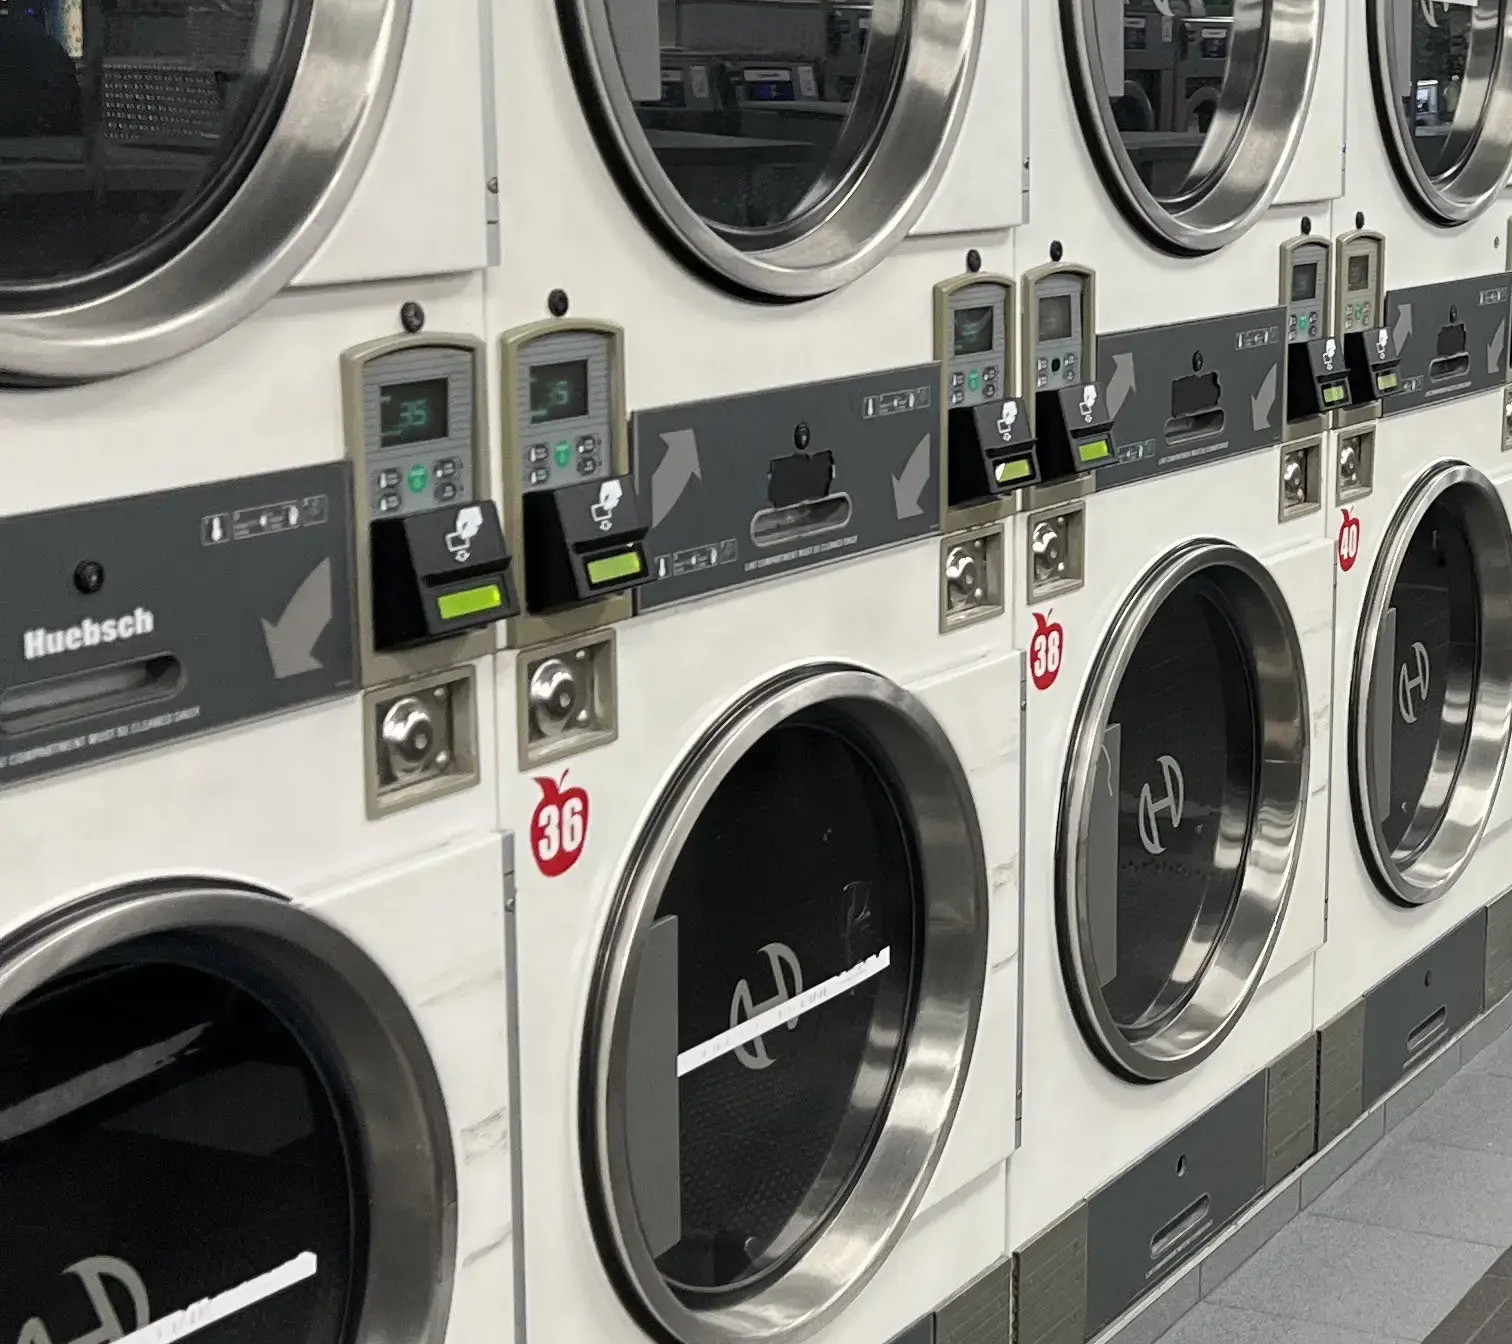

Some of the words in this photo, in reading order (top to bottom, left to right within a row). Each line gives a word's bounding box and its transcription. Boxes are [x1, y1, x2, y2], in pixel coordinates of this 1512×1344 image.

[1341, 524, 1357, 560] 40
[24, 607, 154, 660] Huebsch
[1033, 632, 1062, 676] 38
[538, 788, 583, 861] 36
